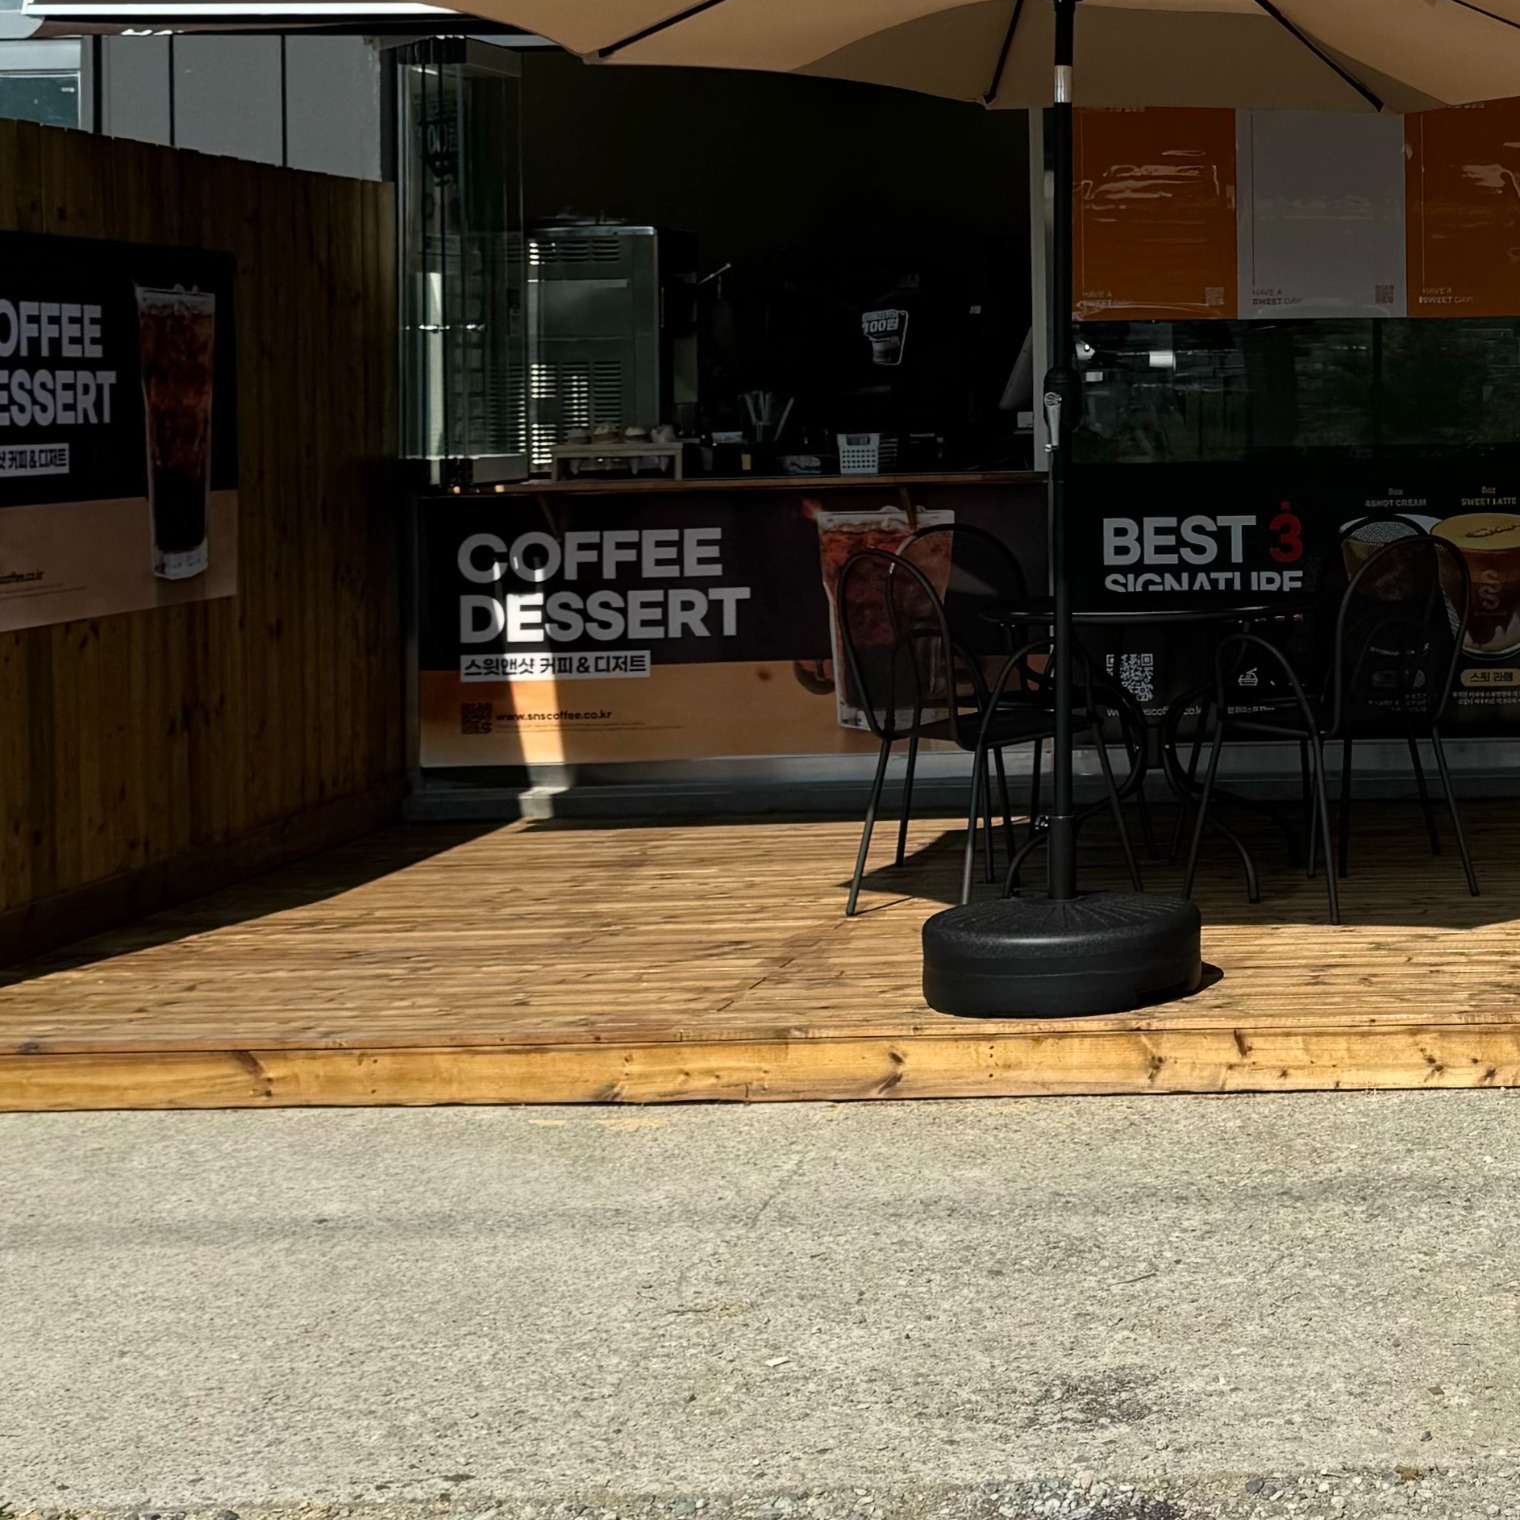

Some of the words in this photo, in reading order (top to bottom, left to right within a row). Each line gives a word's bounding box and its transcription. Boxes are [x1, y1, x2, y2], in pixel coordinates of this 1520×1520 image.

[457, 527, 722, 584] COFFEE
[1103, 515, 1256, 566] BEST
[1267, 512, 1304, 564] 3
[459, 587, 750, 643] DESSERT
[464, 657, 535, 676] 스윗앤샷
[540, 656, 573, 675] 커피
[577, 657, 591, 674] &
[595, 655, 647, 673] 디저트
[496, 710, 613, 721] www.snscoffee.co.kr
